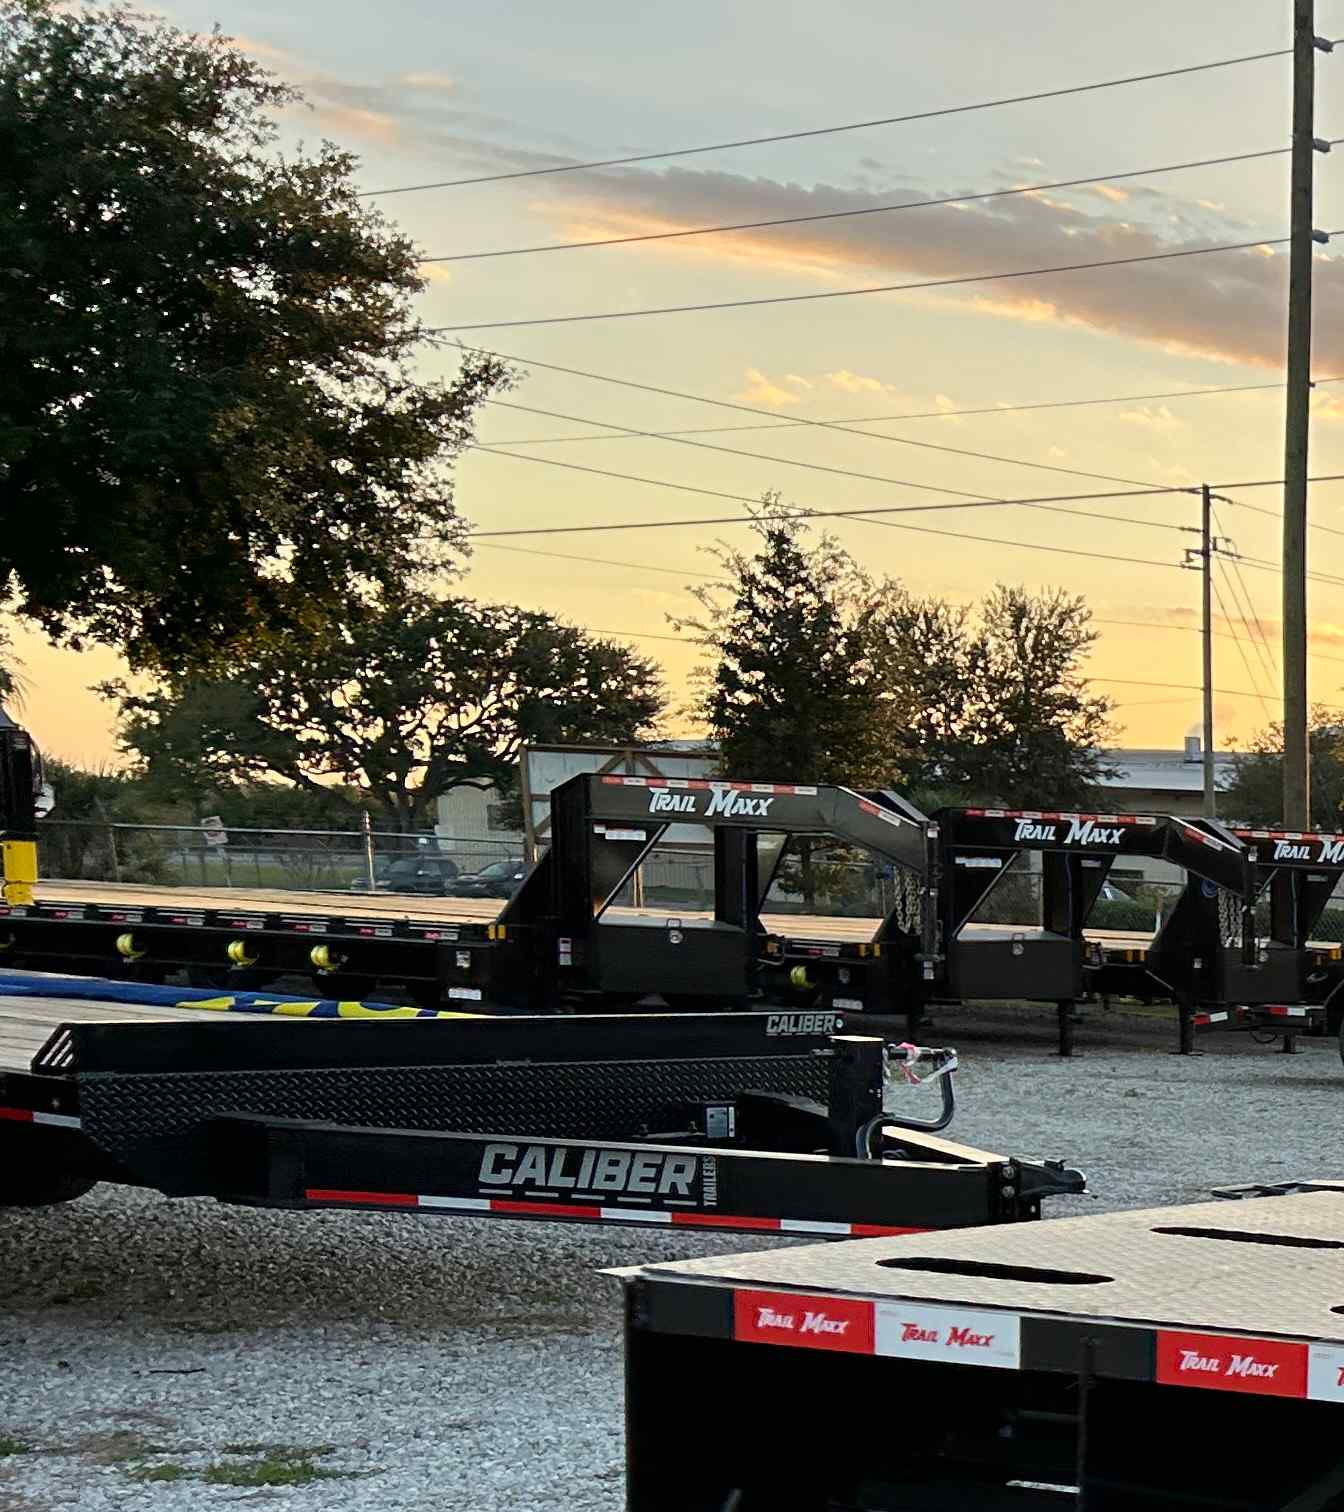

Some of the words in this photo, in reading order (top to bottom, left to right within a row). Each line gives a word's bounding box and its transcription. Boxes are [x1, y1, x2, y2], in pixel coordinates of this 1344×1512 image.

[649, 787, 697, 813] TRAIL
[704, 787, 775, 818] MAXX
[1014, 818, 1057, 842] TRAIL
[1063, 818, 1126, 846] MAXX
[1273, 839, 1311, 860] TRAIL
[766, 1015, 836, 1033] CALIBER
[478, 1143, 697, 1196] CALIBER
[703, 1155, 717, 1206] TRAILERS
[757, 1307, 793, 1329] TRAIL
[799, 1311, 849, 1334] MAXX
[901, 1322, 939, 1344] TRAIL
[945, 1326, 996, 1348] MAXX
[1179, 1350, 1220, 1373] TRAIL
[1225, 1354, 1279, 1379] MAXX
